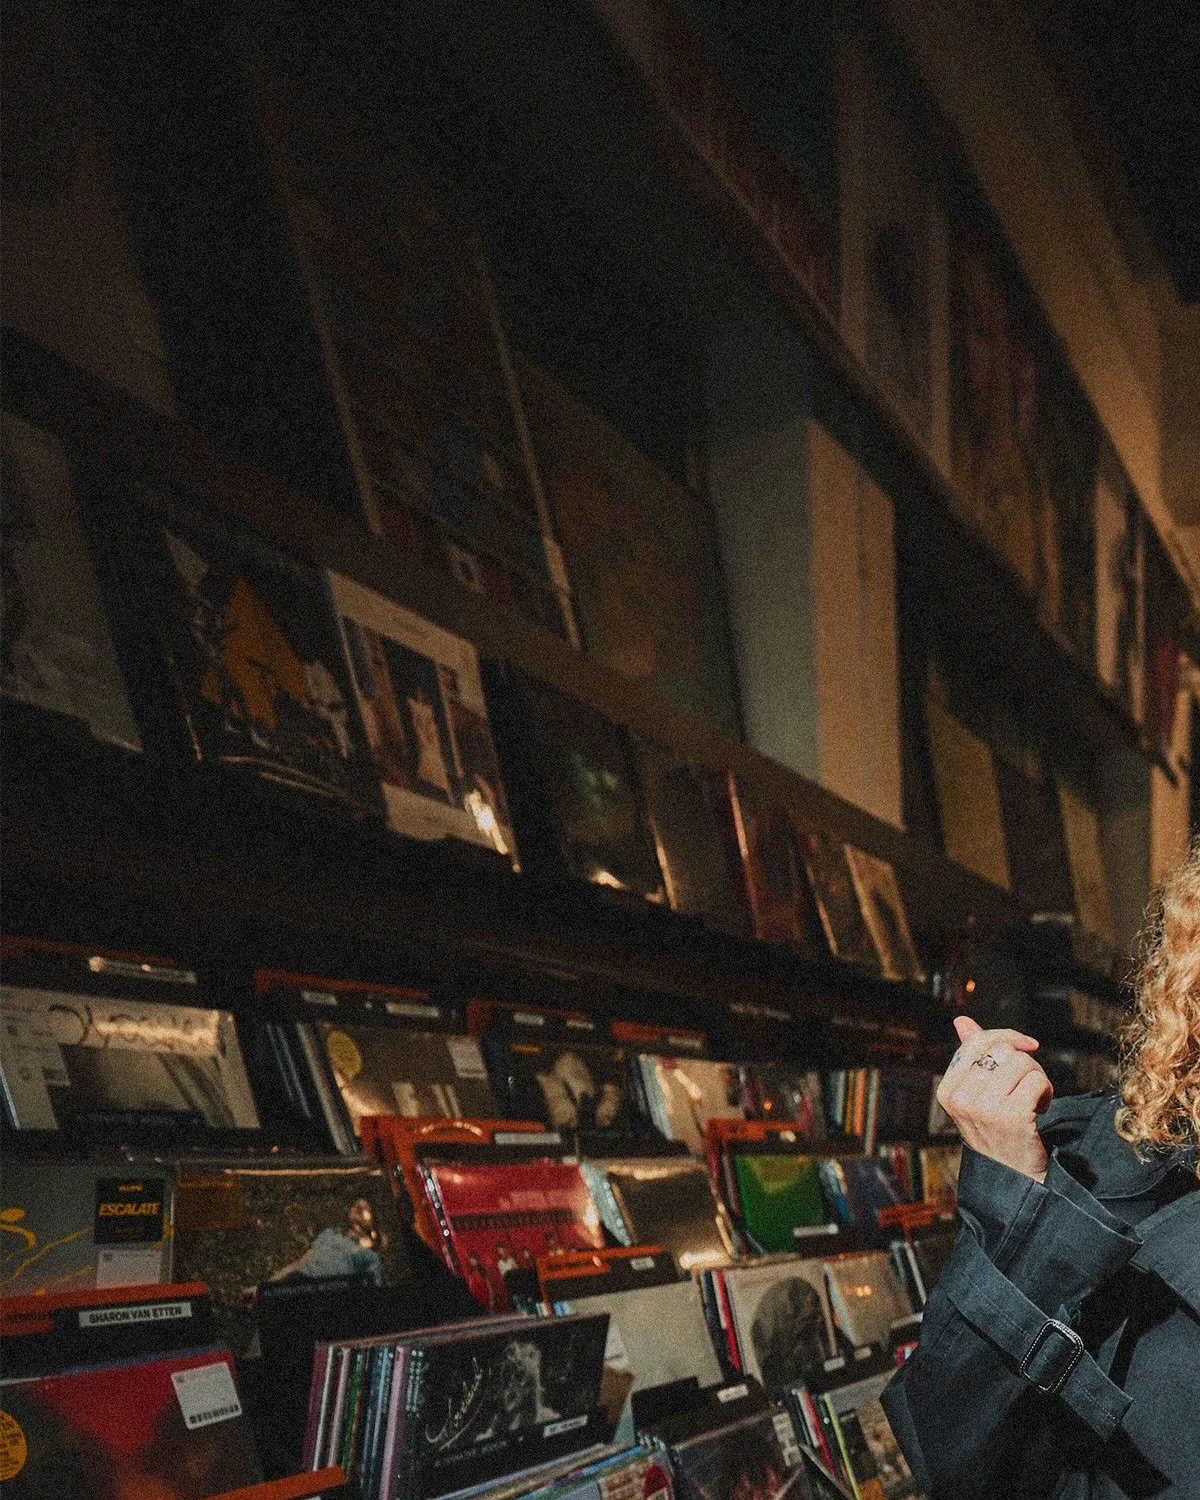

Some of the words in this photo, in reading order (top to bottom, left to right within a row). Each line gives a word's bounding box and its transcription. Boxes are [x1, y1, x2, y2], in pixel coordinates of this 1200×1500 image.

[98, 1201, 161, 1217] ESCALATE
[89, 1311, 130, 1324] SHARON
[132, 1308, 150, 1320] VAN
[151, 1305, 181, 1318] ETTEN
